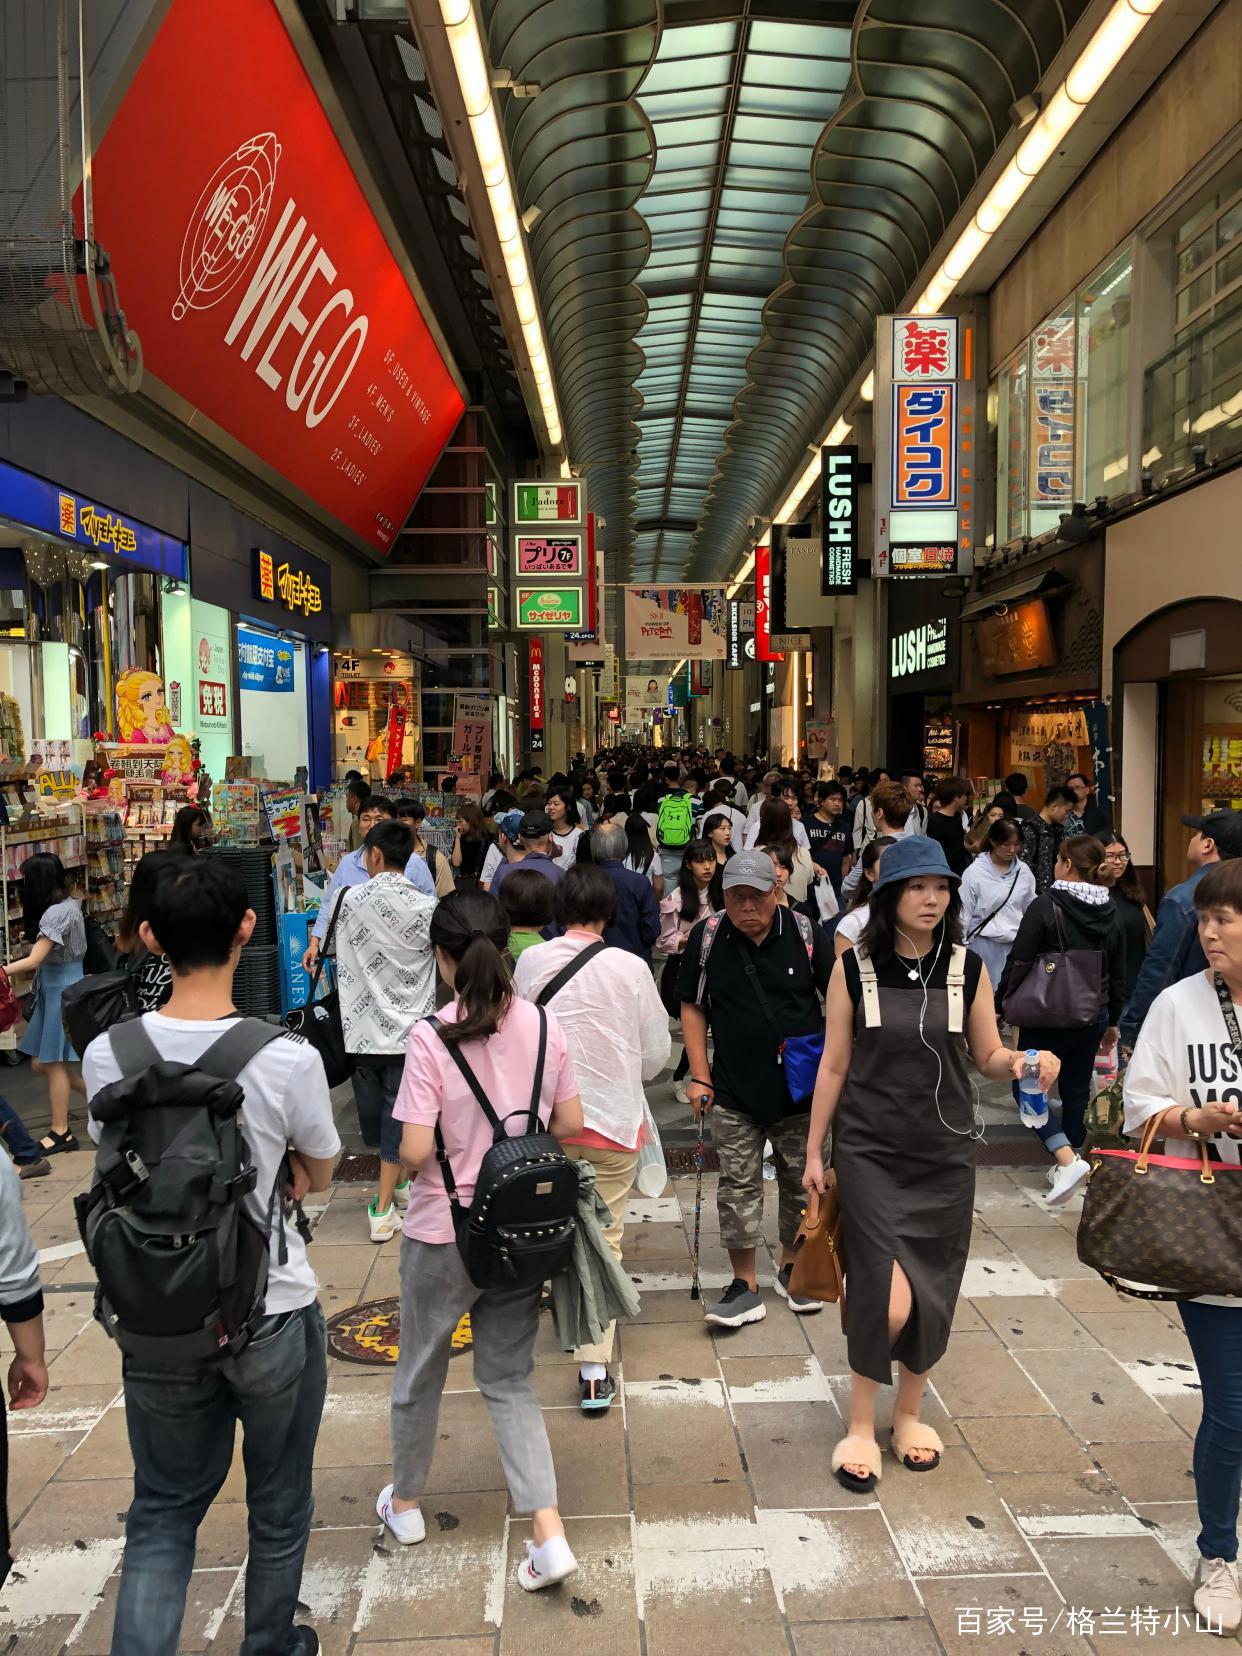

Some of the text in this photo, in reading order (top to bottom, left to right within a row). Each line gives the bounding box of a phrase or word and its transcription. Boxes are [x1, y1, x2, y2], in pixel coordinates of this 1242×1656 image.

[224, 197, 368, 428] WEGO
[904, 322, 947, 374] 薬
[904, 388, 946, 498] ダイコク
[829, 456, 852, 542] LUSH
[525, 548, 556, 564] プリ
[560, 551, 572, 561] 7F
[842, 547, 852, 585] FRESH
[528, 610, 572, 622] サイゼリヤ
[342, 660, 360, 671] 4F
[892, 626, 926, 678] LUSH
[202, 684, 224, 715] 免税
[810, 829, 845, 841] HILFGER
